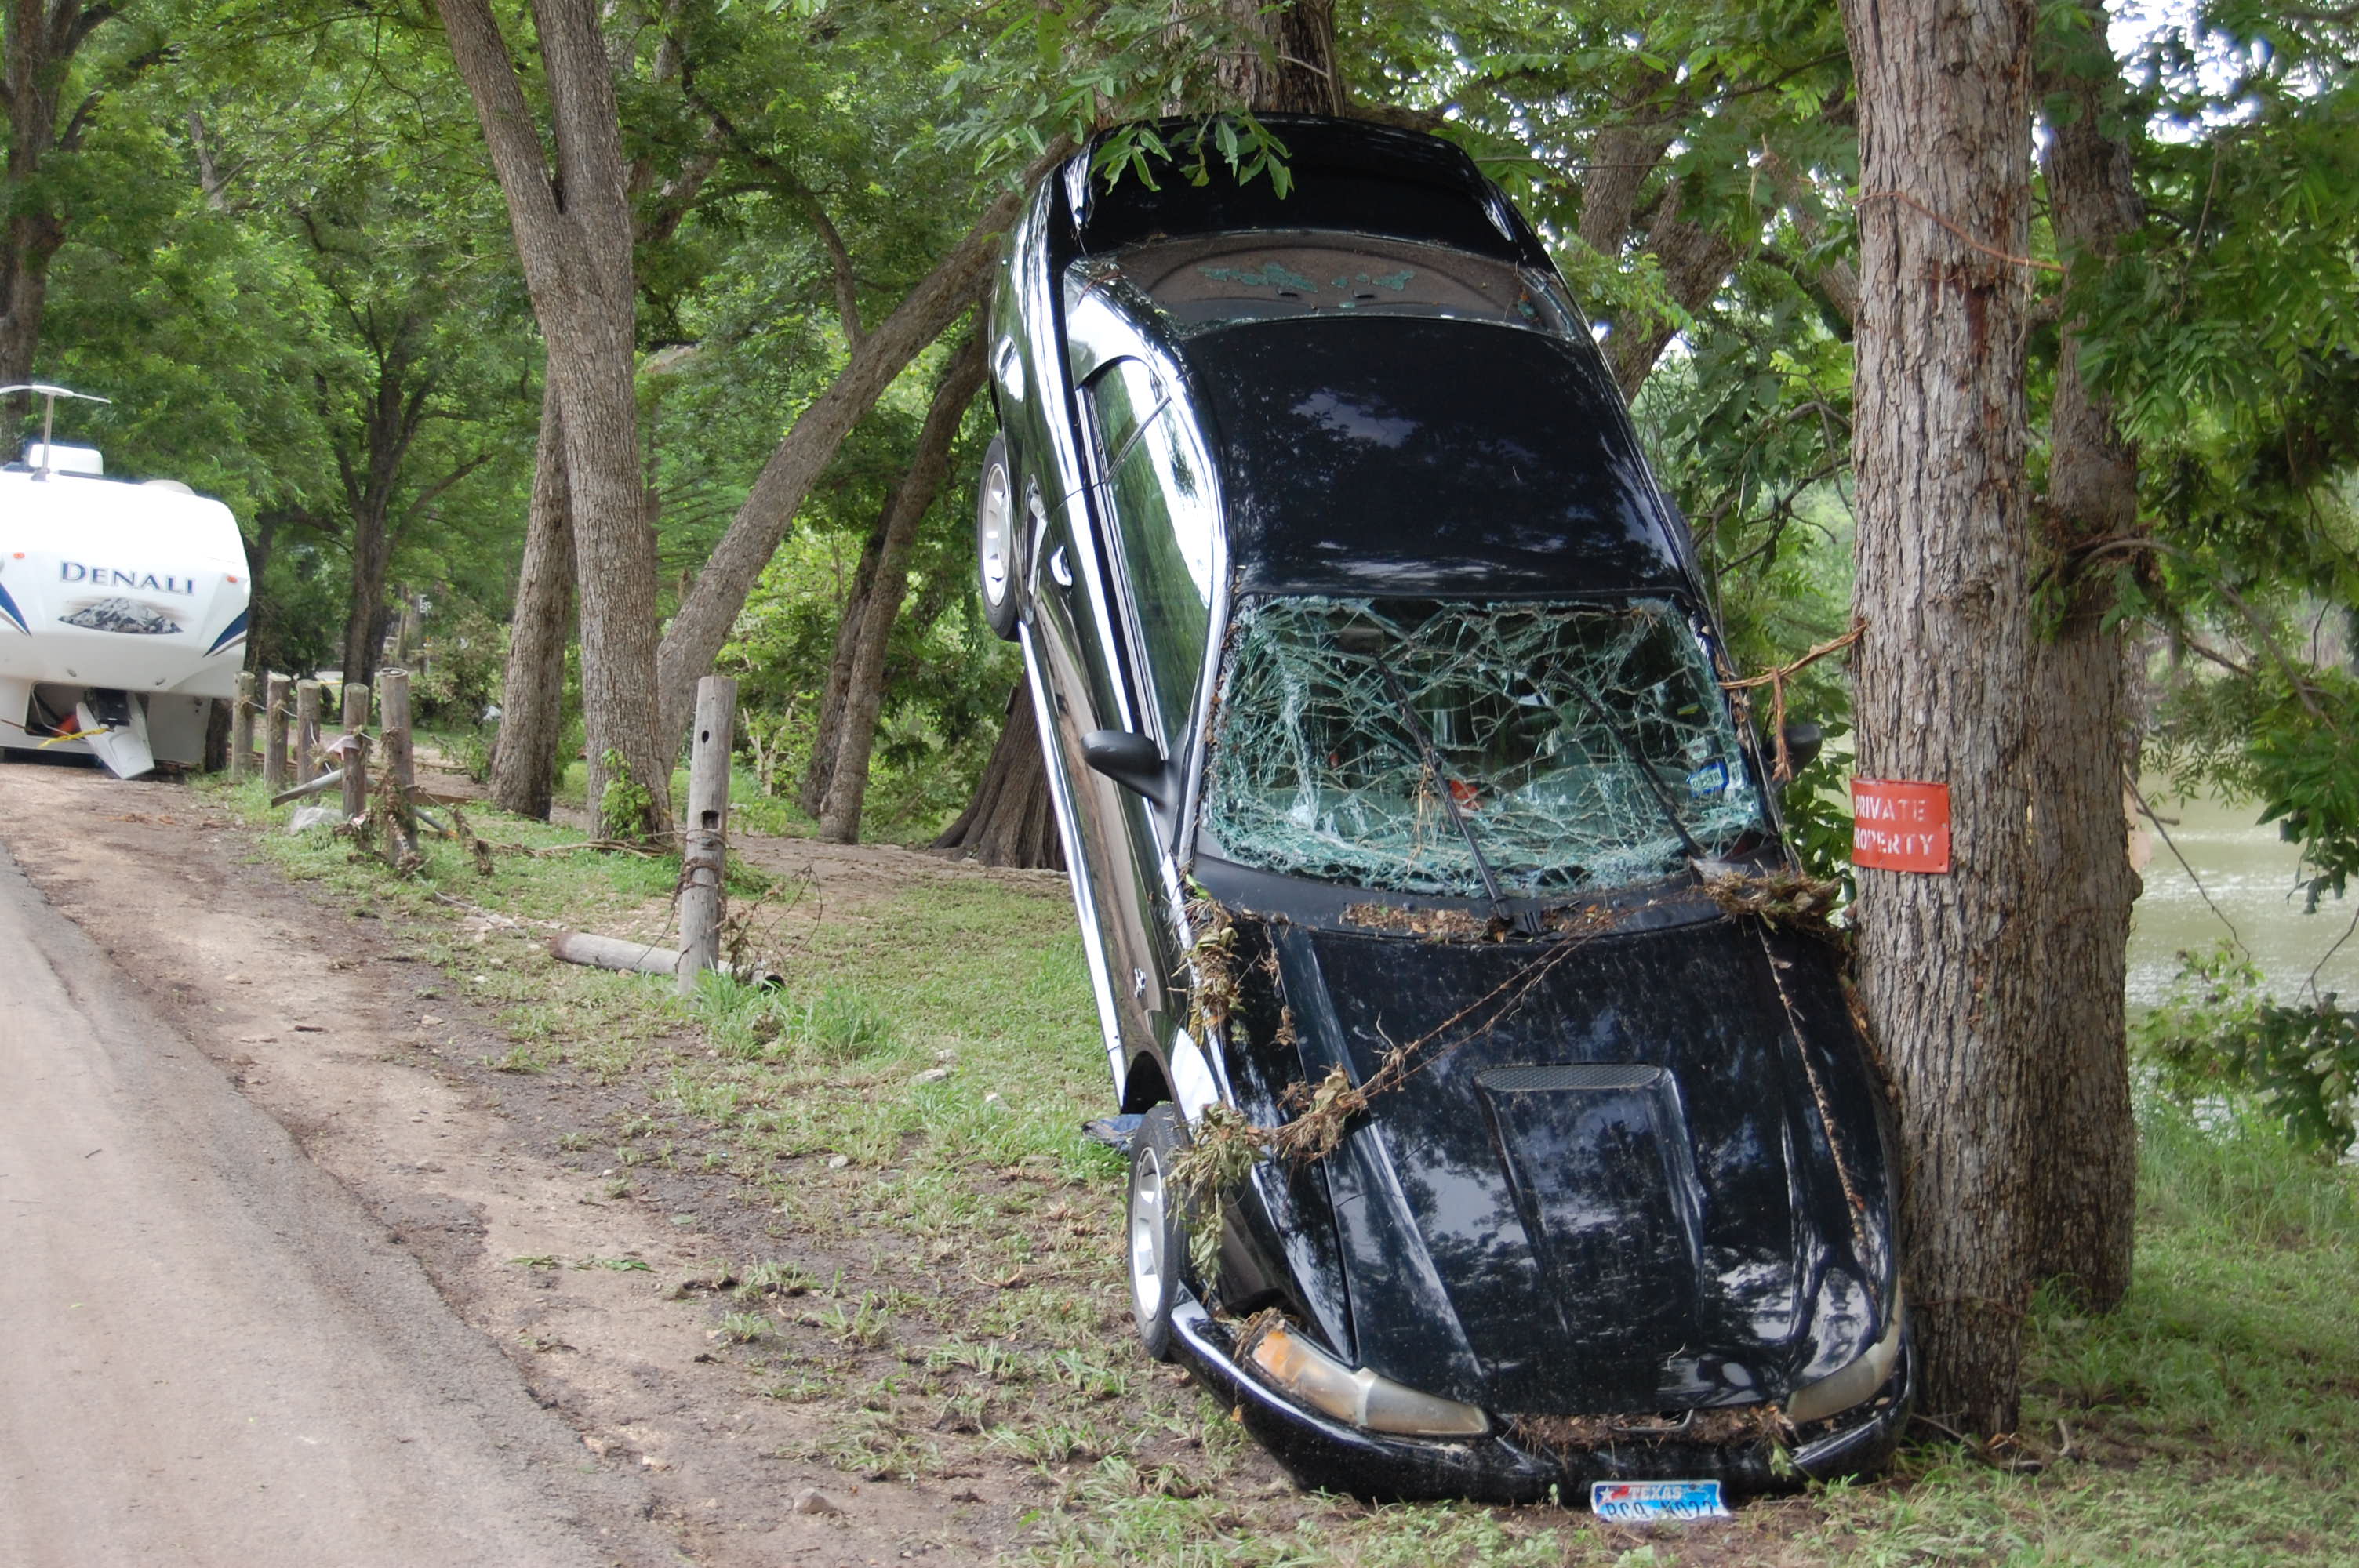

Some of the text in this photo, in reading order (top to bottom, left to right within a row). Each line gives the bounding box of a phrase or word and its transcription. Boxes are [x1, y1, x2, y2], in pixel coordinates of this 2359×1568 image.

[60, 560, 196, 596] DENALI
[1856, 794, 1927, 822] PRIVATE
[1628, 1485, 1683, 1501] TEXAS
